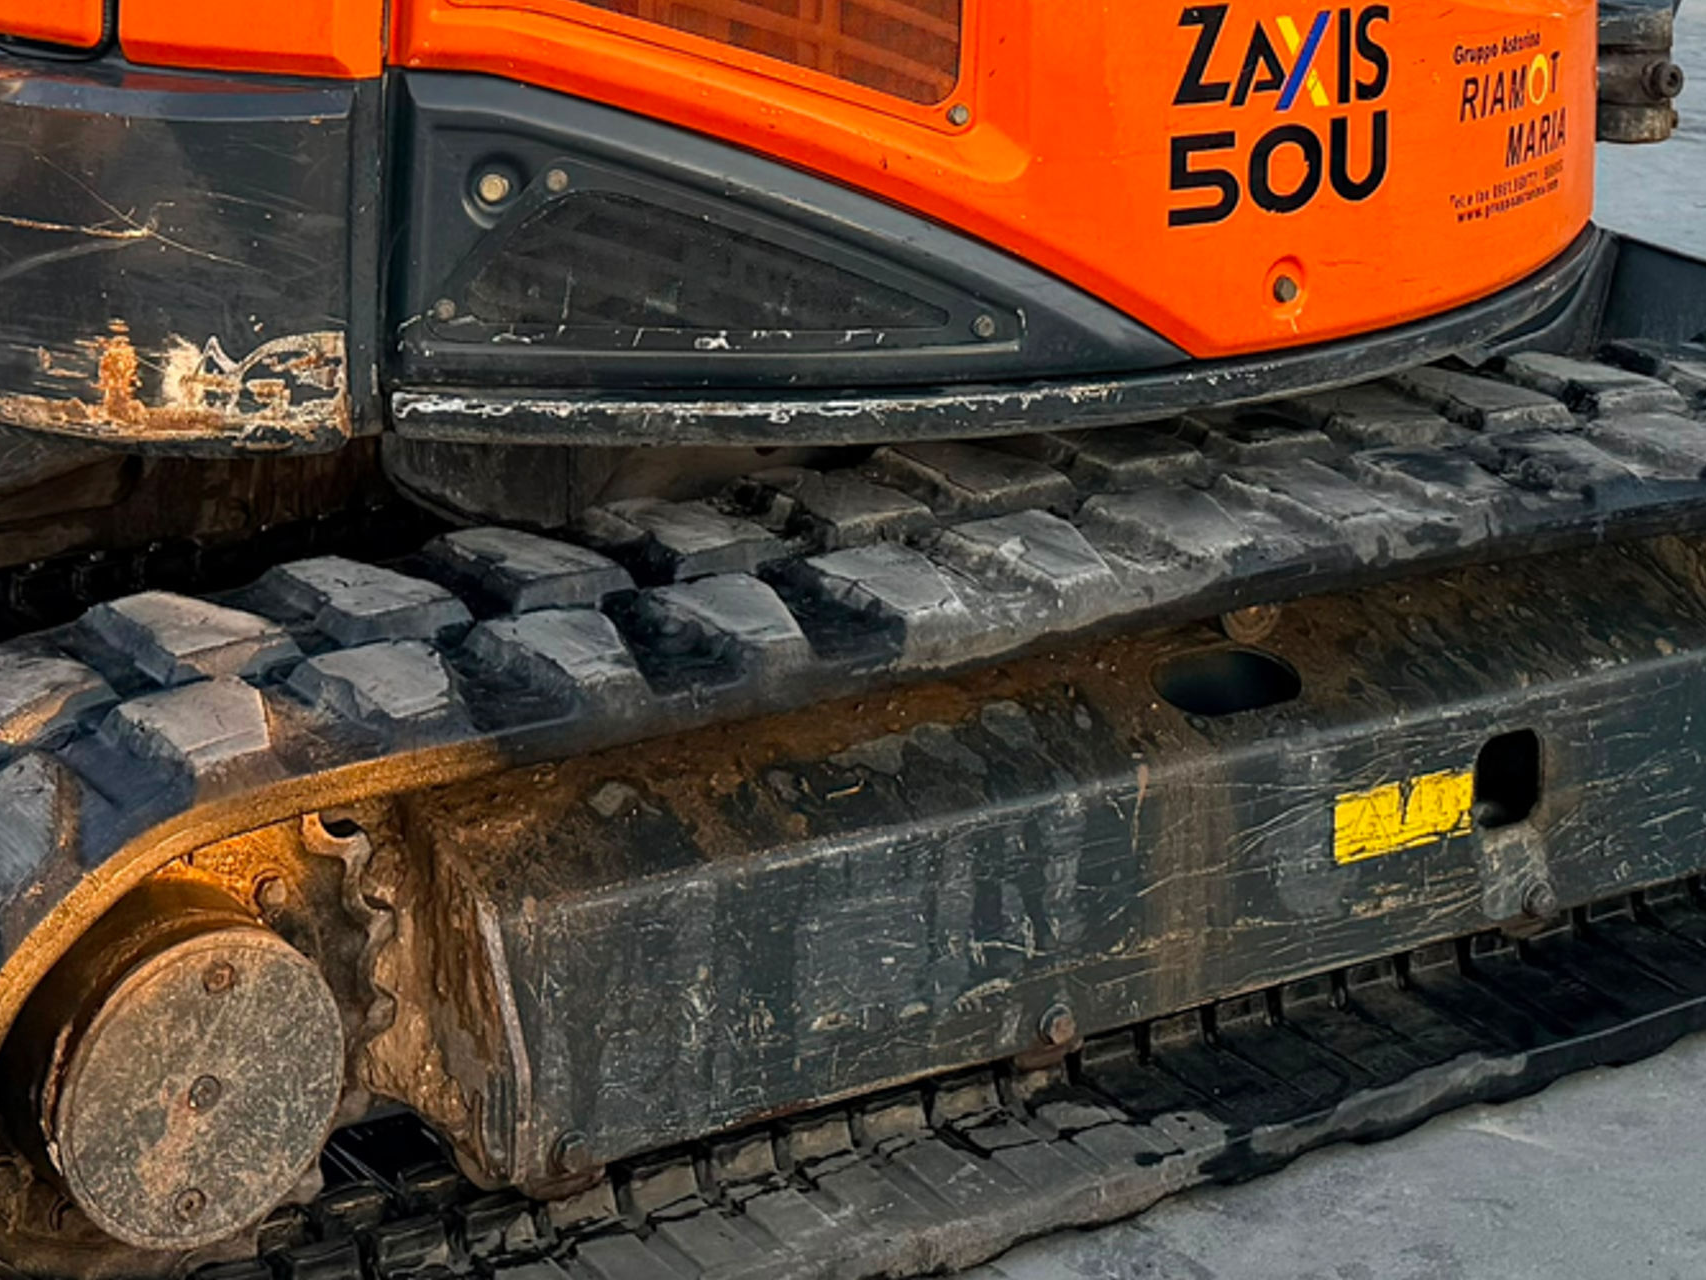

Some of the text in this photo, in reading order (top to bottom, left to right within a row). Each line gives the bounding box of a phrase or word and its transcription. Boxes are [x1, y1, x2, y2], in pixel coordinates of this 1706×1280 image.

[1171, 3, 1390, 111] ZAXIS
[1453, 42, 1498, 65] Gruppo
[1459, 51, 1561, 123] RIAMOT
[1167, 108, 1389, 228] 50U
[1505, 106, 1567, 168] MARIA
